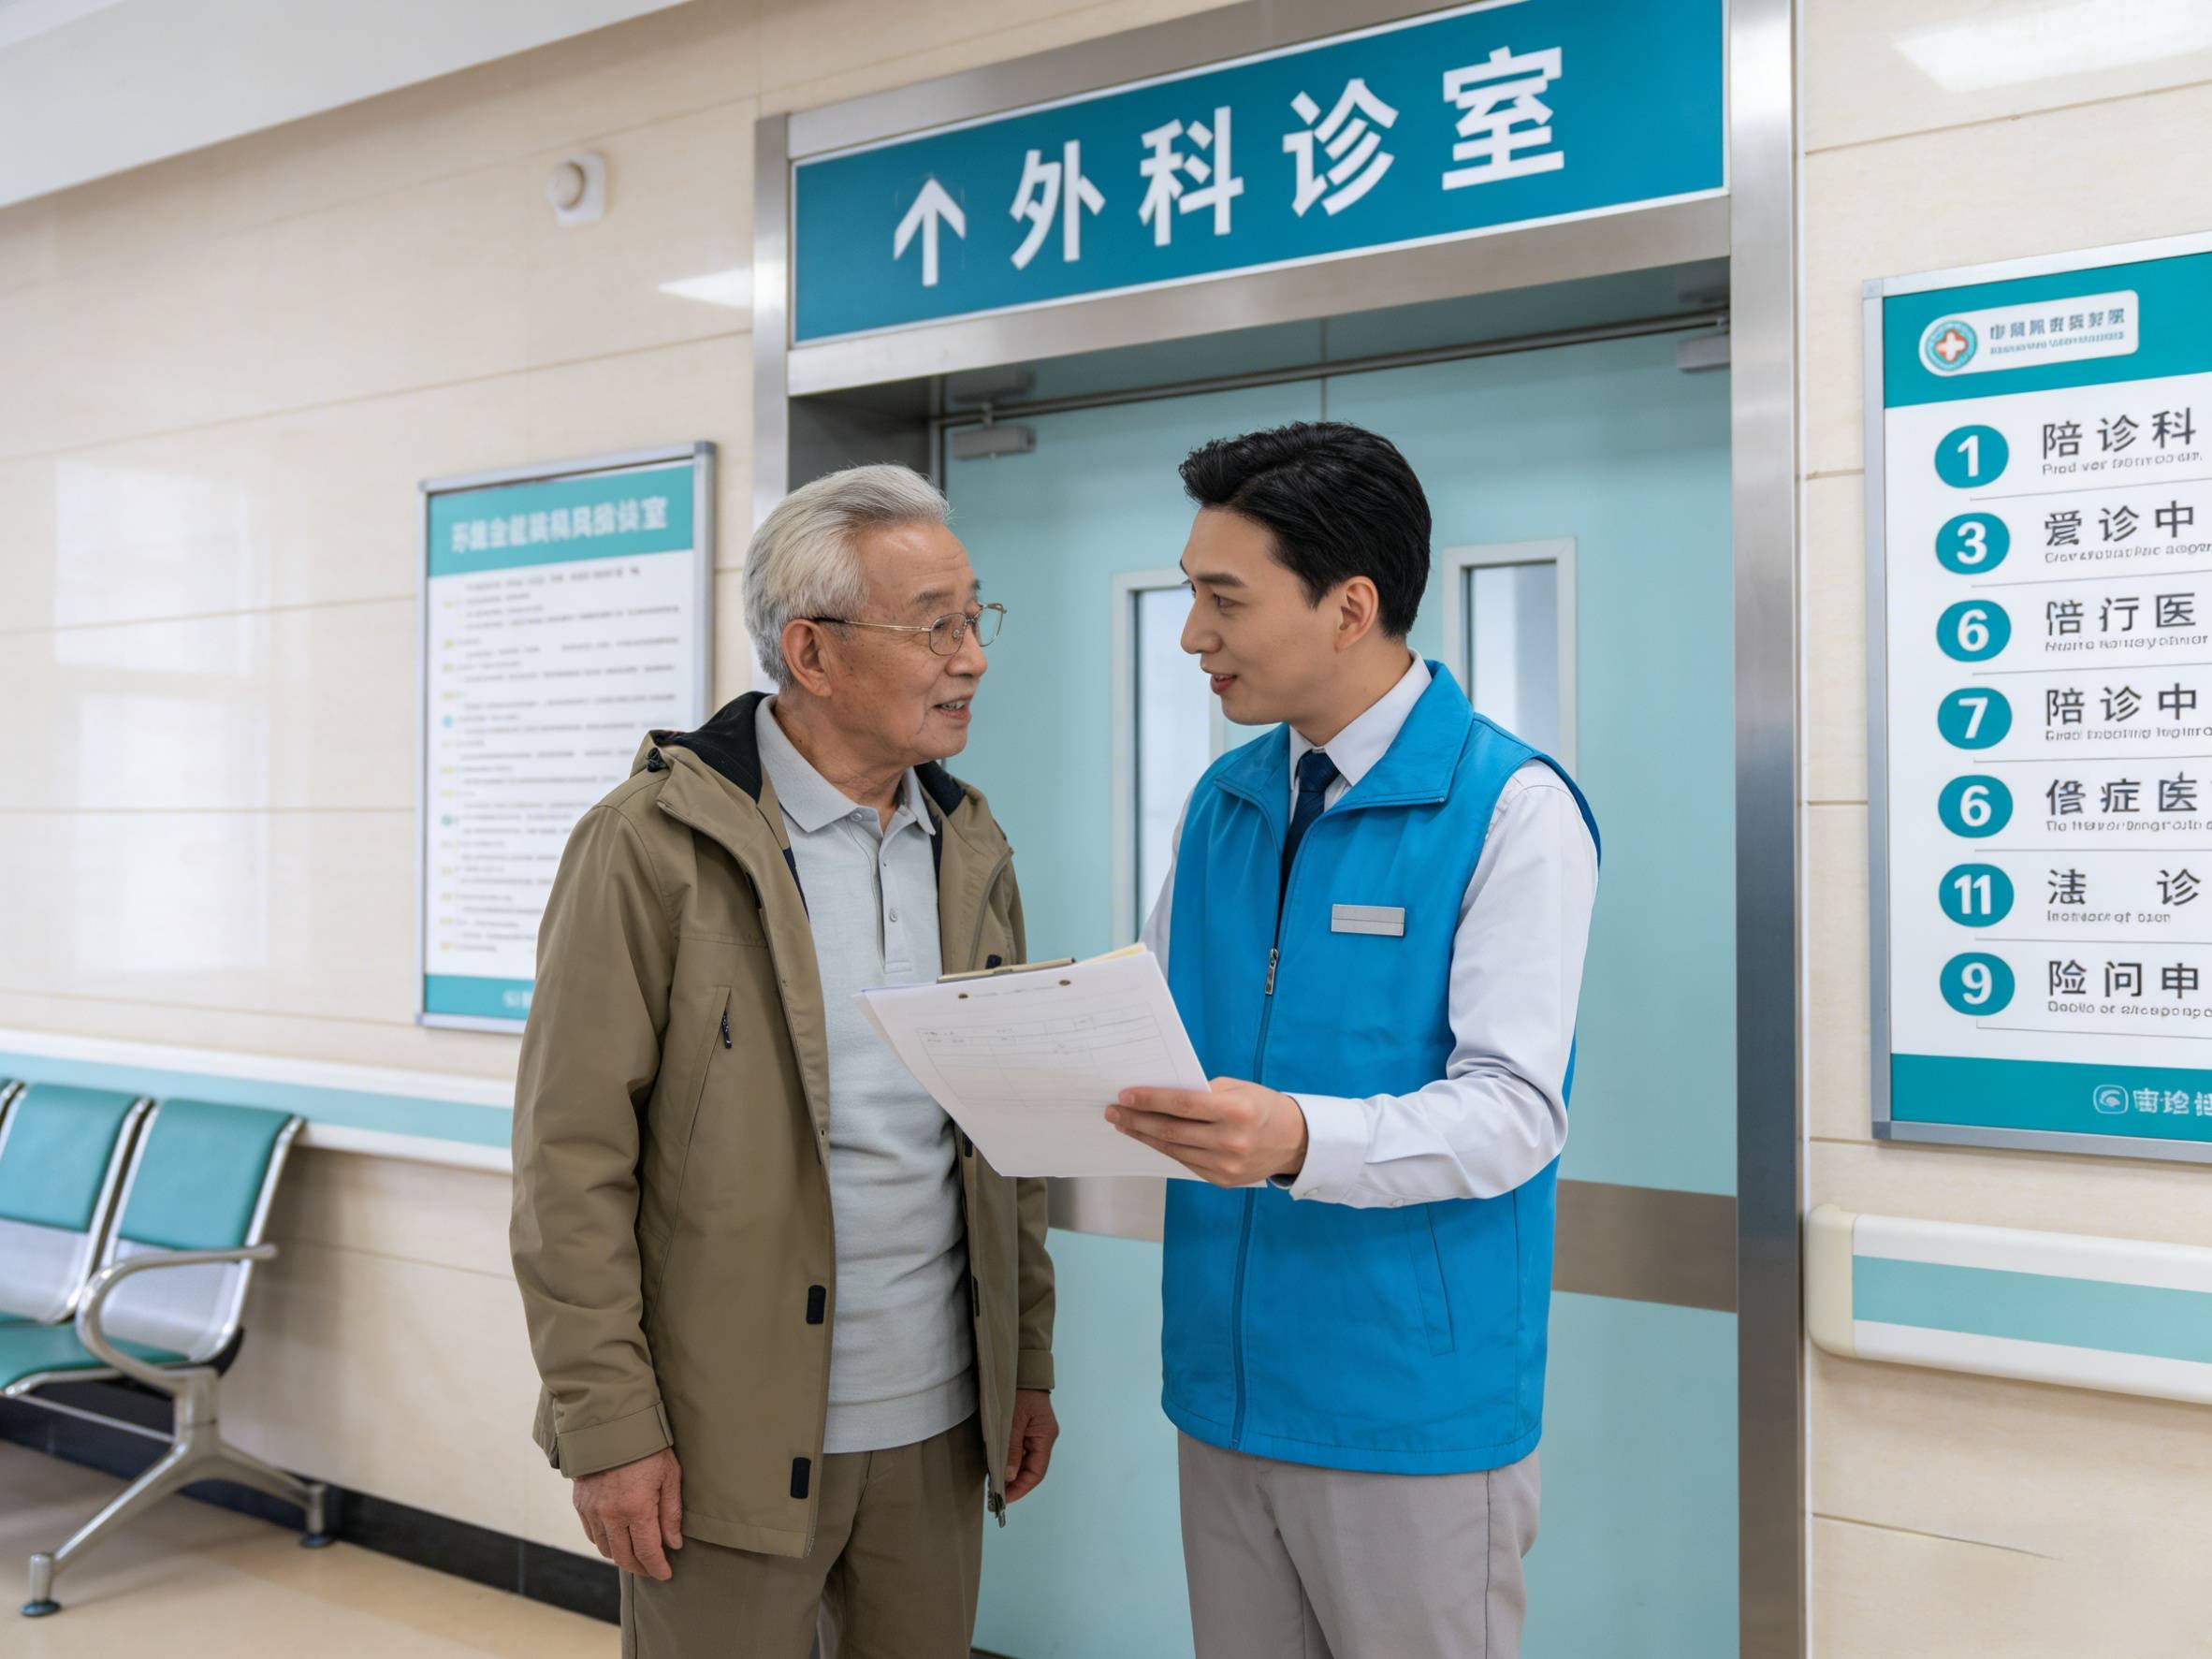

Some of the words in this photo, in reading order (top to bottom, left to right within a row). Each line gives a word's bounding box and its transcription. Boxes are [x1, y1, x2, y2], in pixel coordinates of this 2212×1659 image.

[1009, 46, 1564, 271] 外科诊室
[1957, 434, 1979, 477] 1
[1957, 521, 1987, 564] 3
[1957, 609, 1989, 651] 6
[1958, 697, 1988, 739] 7
[1960, 785, 1992, 827] 6
[1954, 874, 1991, 915] 11
[1961, 962, 1992, 1005] 9
[2048, 959, 2199, 999] 险问申
